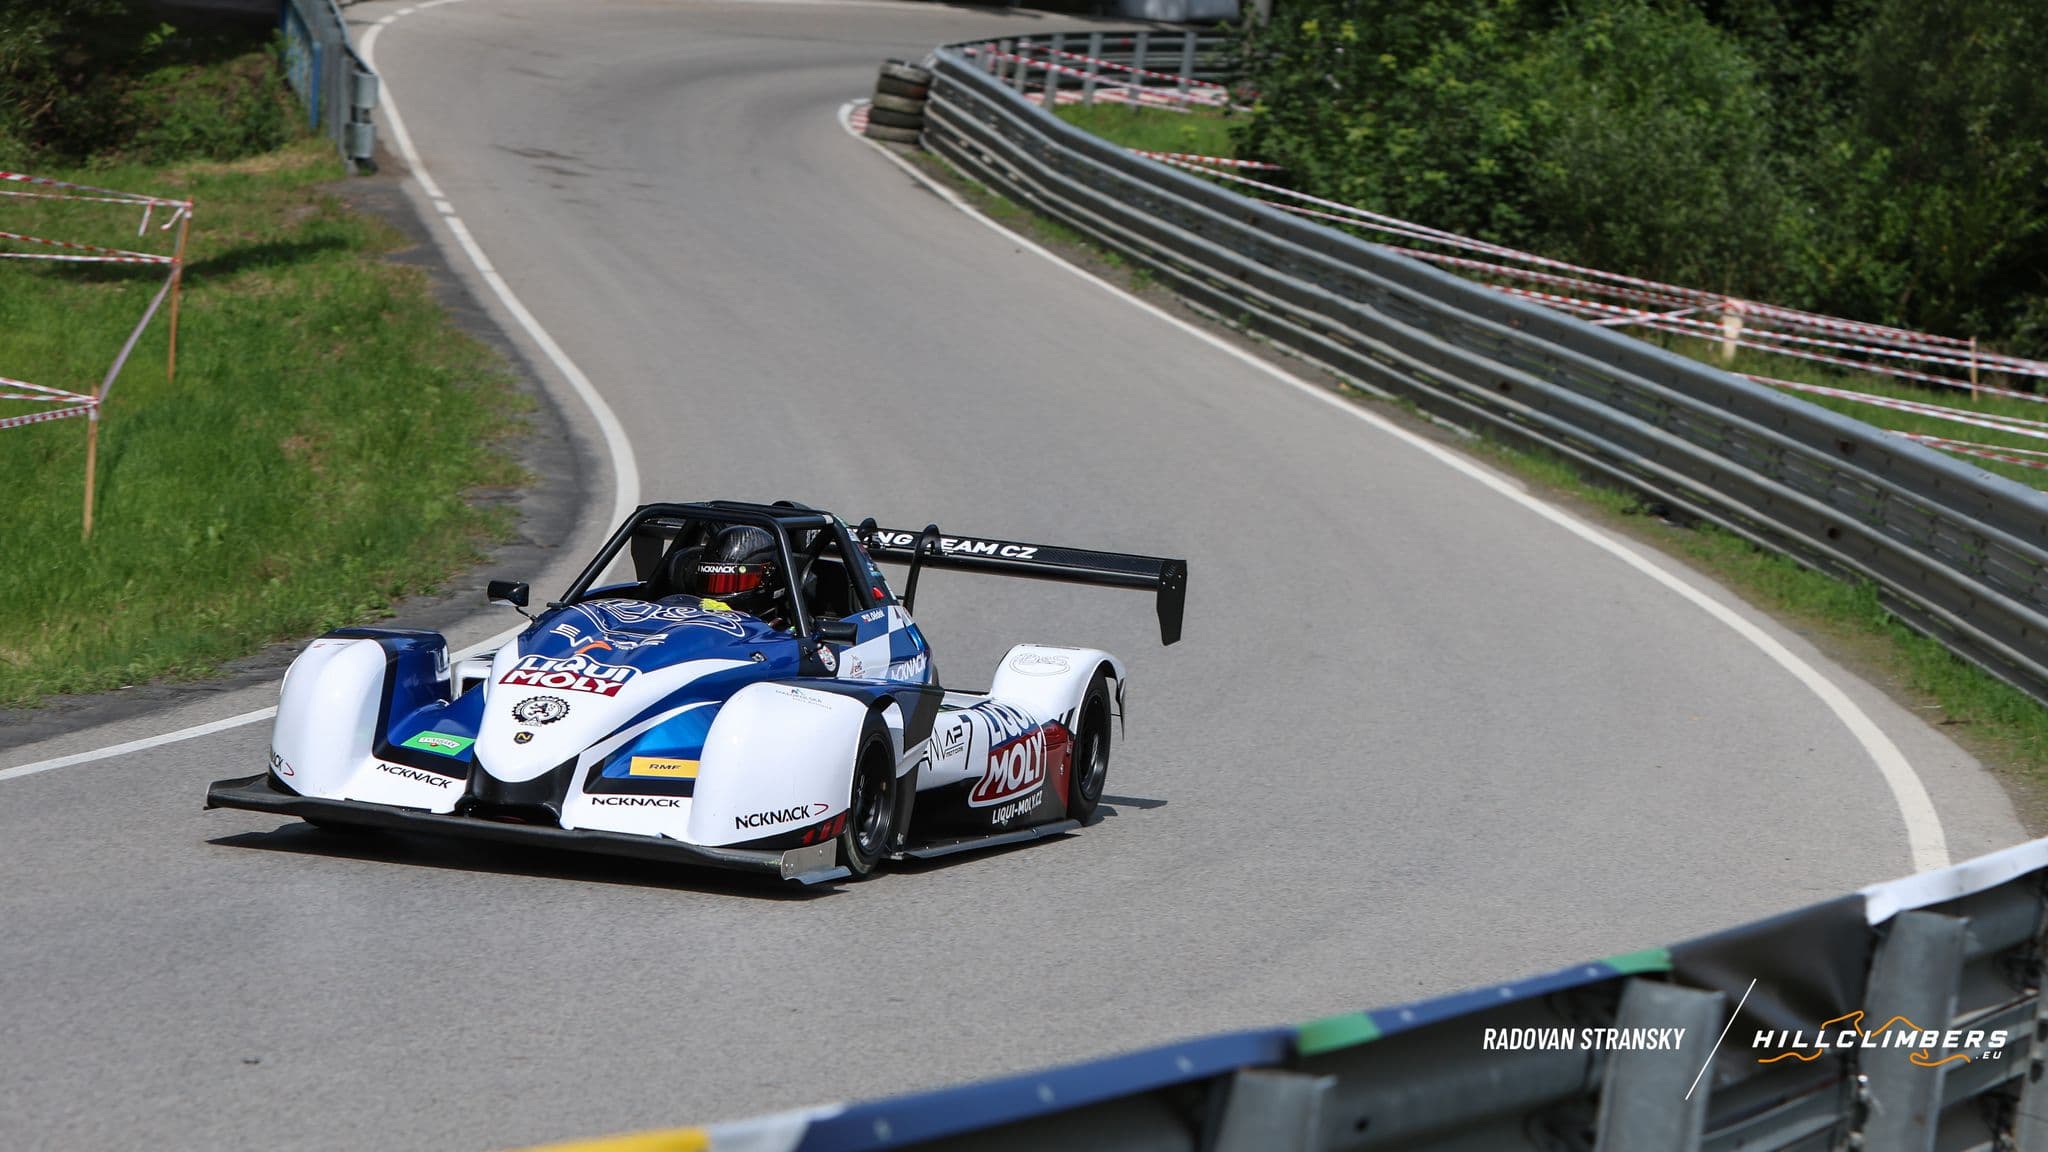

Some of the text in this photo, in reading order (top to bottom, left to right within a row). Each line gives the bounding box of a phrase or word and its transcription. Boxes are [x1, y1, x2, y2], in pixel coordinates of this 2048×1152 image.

[928, 538, 998, 555] EAM
[1000, 545, 1037, 558] CZ
[519, 656, 627, 682] LIQUI
[504, 671, 624, 694] MOLY
[649, 763, 682, 771] RMF
[978, 731, 1043, 797] MOLY
